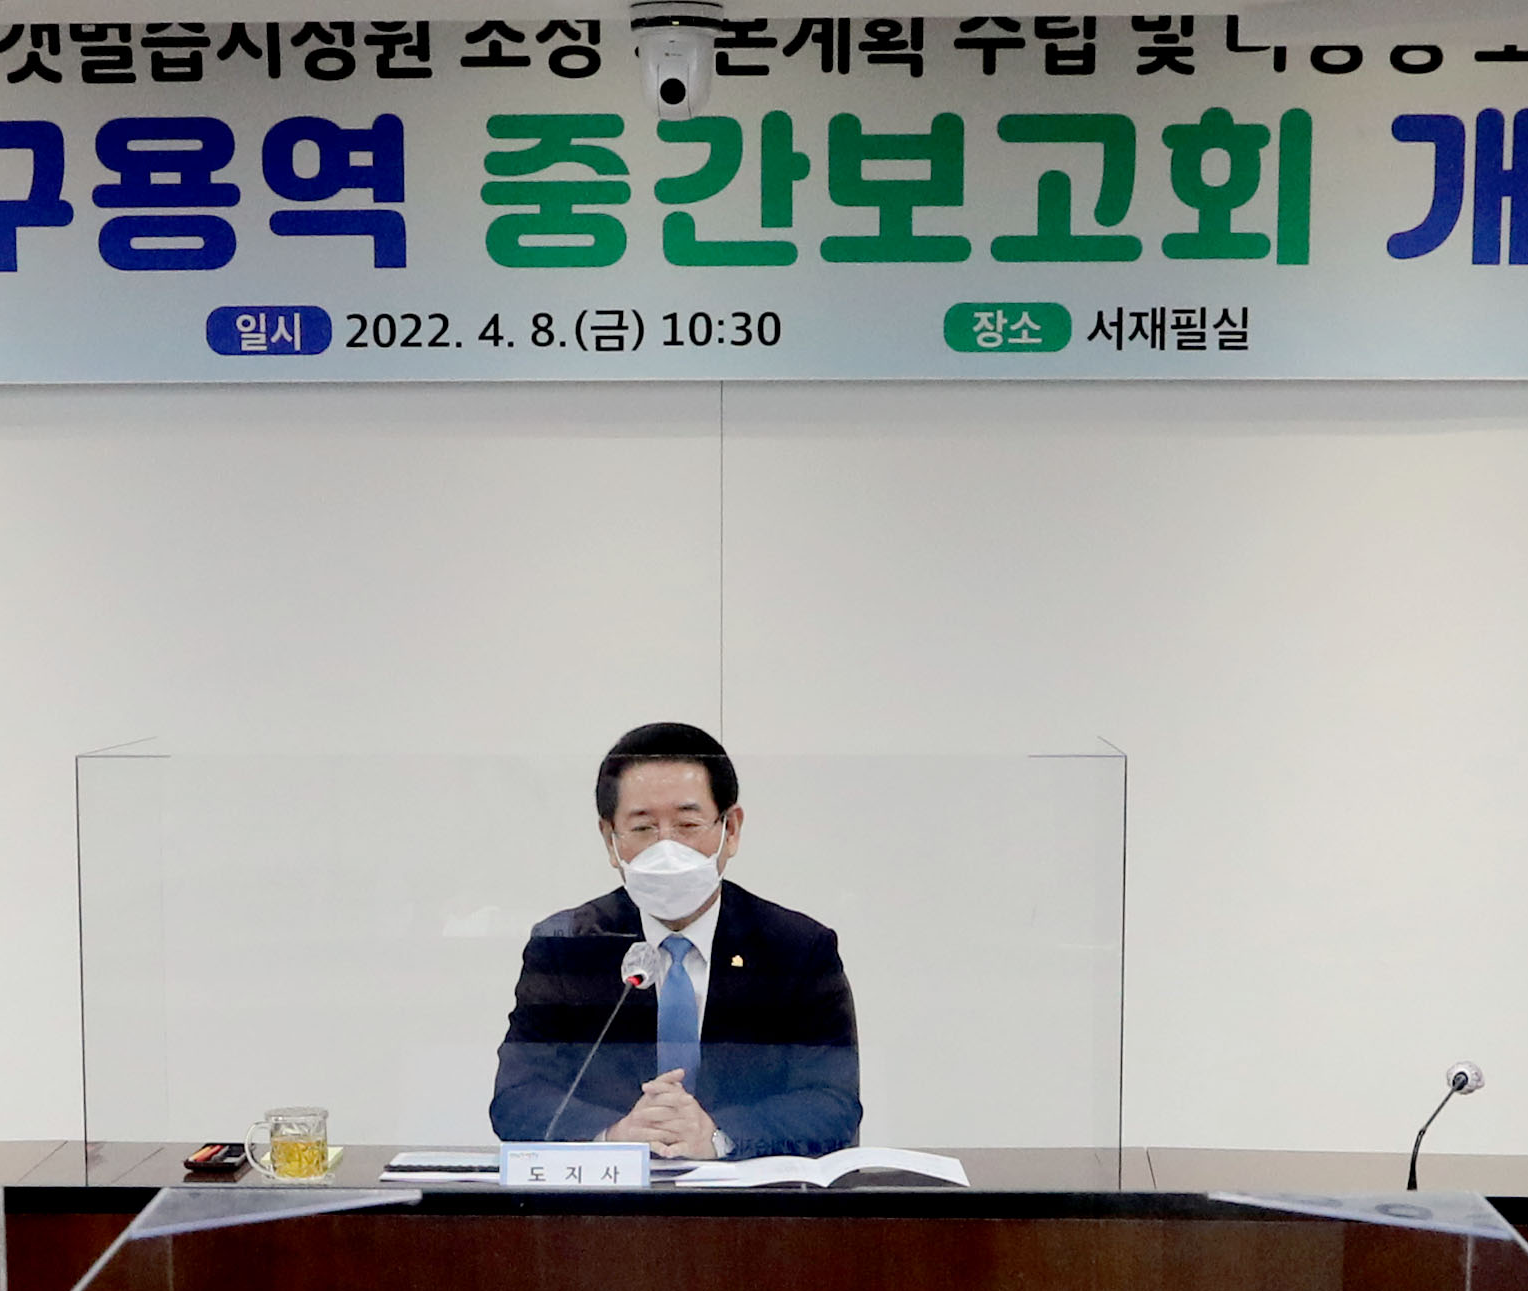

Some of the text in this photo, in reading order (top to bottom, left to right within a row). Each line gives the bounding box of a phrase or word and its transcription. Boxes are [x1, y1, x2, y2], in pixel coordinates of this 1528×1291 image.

[635, 18, 925, 78] 본계획
[480, 107, 1313, 268] 중간보고회
[234, 312, 303, 352] 일시
[346, 313, 462, 348] 2022.
[478, 314, 514, 348] 4.
[662, 312, 781, 347] 10:30
[972, 306, 1249, 351] 장소 서재필실
